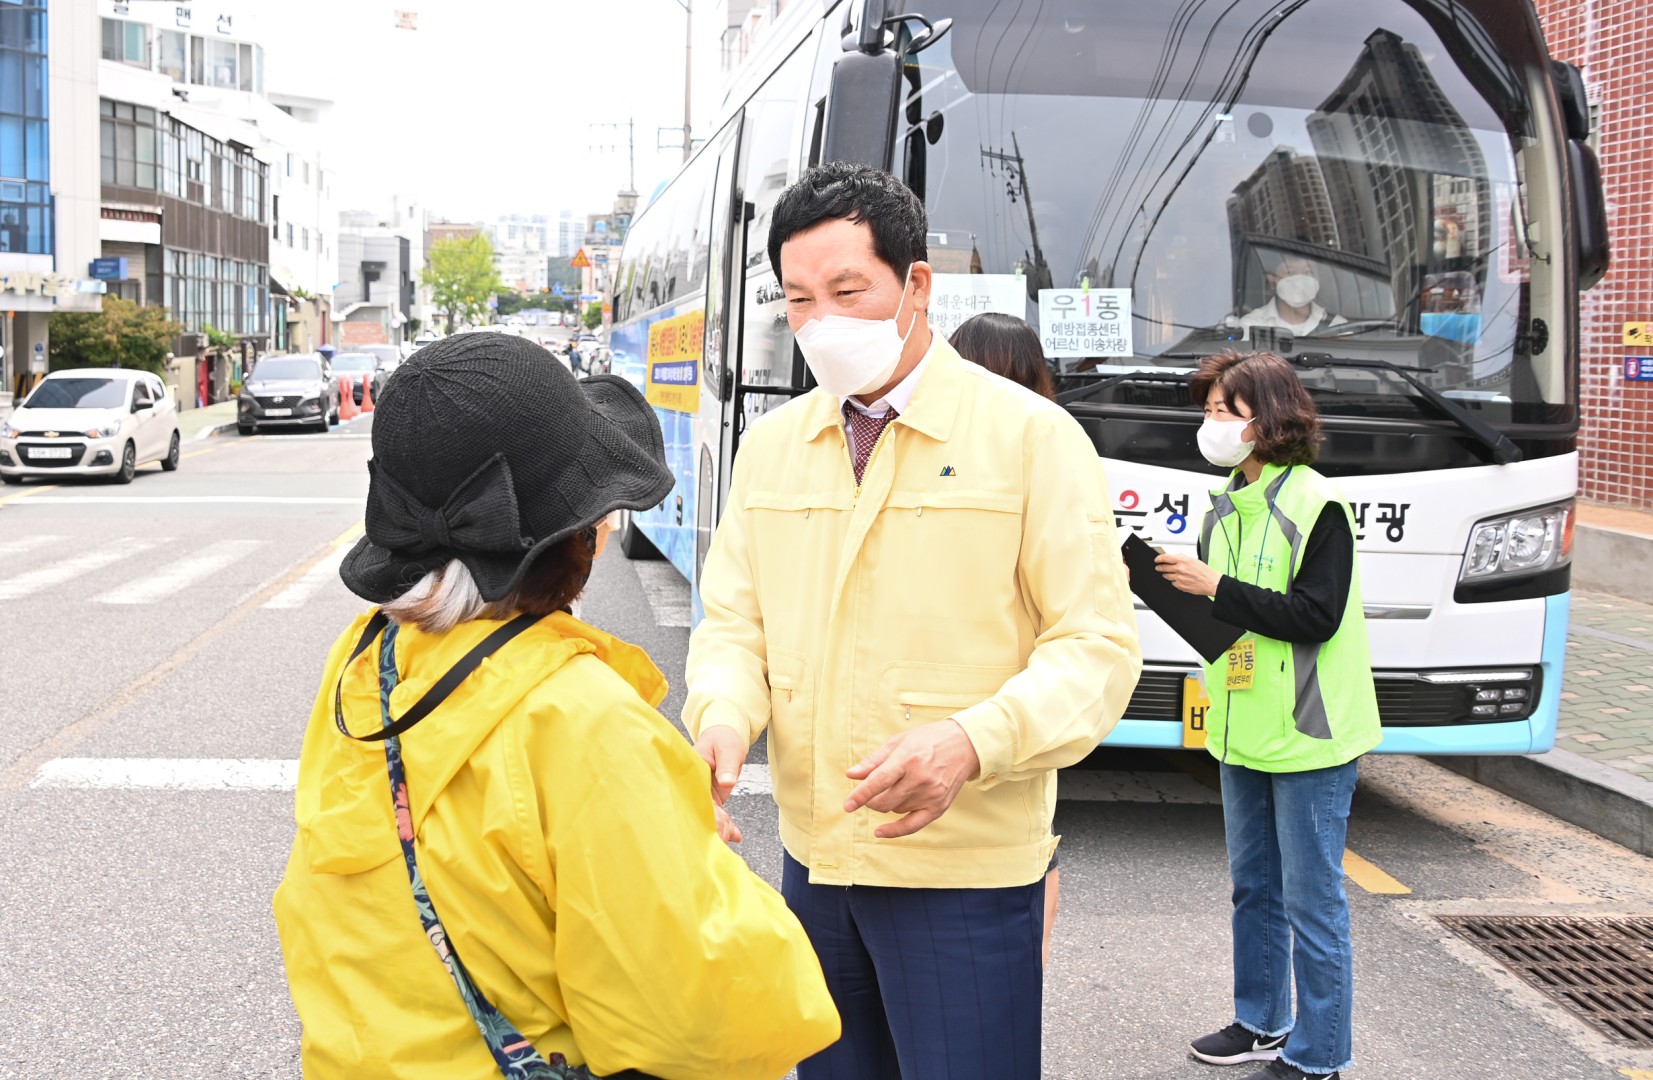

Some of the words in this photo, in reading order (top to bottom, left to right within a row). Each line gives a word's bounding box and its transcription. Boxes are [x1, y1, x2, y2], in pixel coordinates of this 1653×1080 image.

[936, 294, 991, 310] 해운대구
[1051, 295, 1120, 320] 우1동
[1052, 322, 1120, 336] 예방접종센터
[1045, 337, 1079, 351] 어르신
[1084, 337, 1128, 352] 이송차량
[1229, 650, 1254, 671] 우1동
